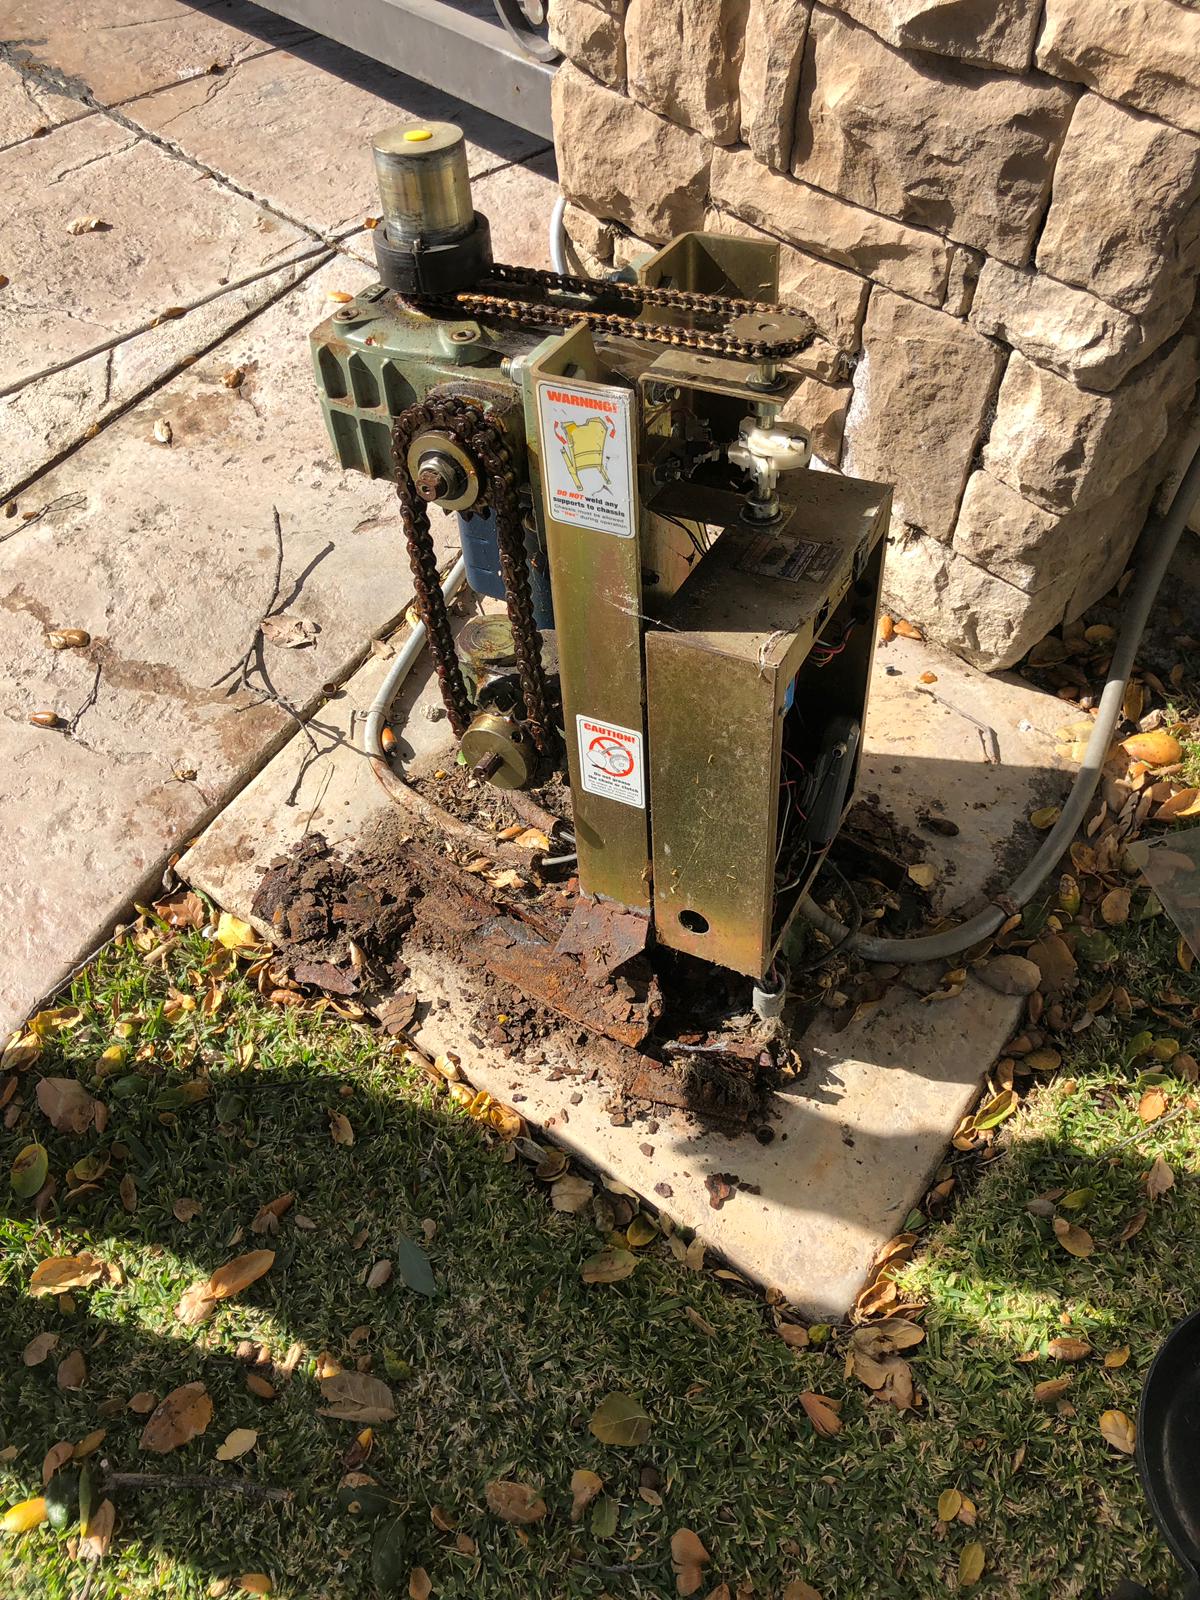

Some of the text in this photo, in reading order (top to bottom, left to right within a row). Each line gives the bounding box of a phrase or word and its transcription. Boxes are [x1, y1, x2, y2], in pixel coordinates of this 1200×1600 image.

[546, 390, 618, 413] WARNING!
[553, 496, 585, 508] supports
[597, 505, 625, 517] chassis
[556, 489, 619, 509] DO NOT weld any
[583, 722, 636, 744] CAUTION!
